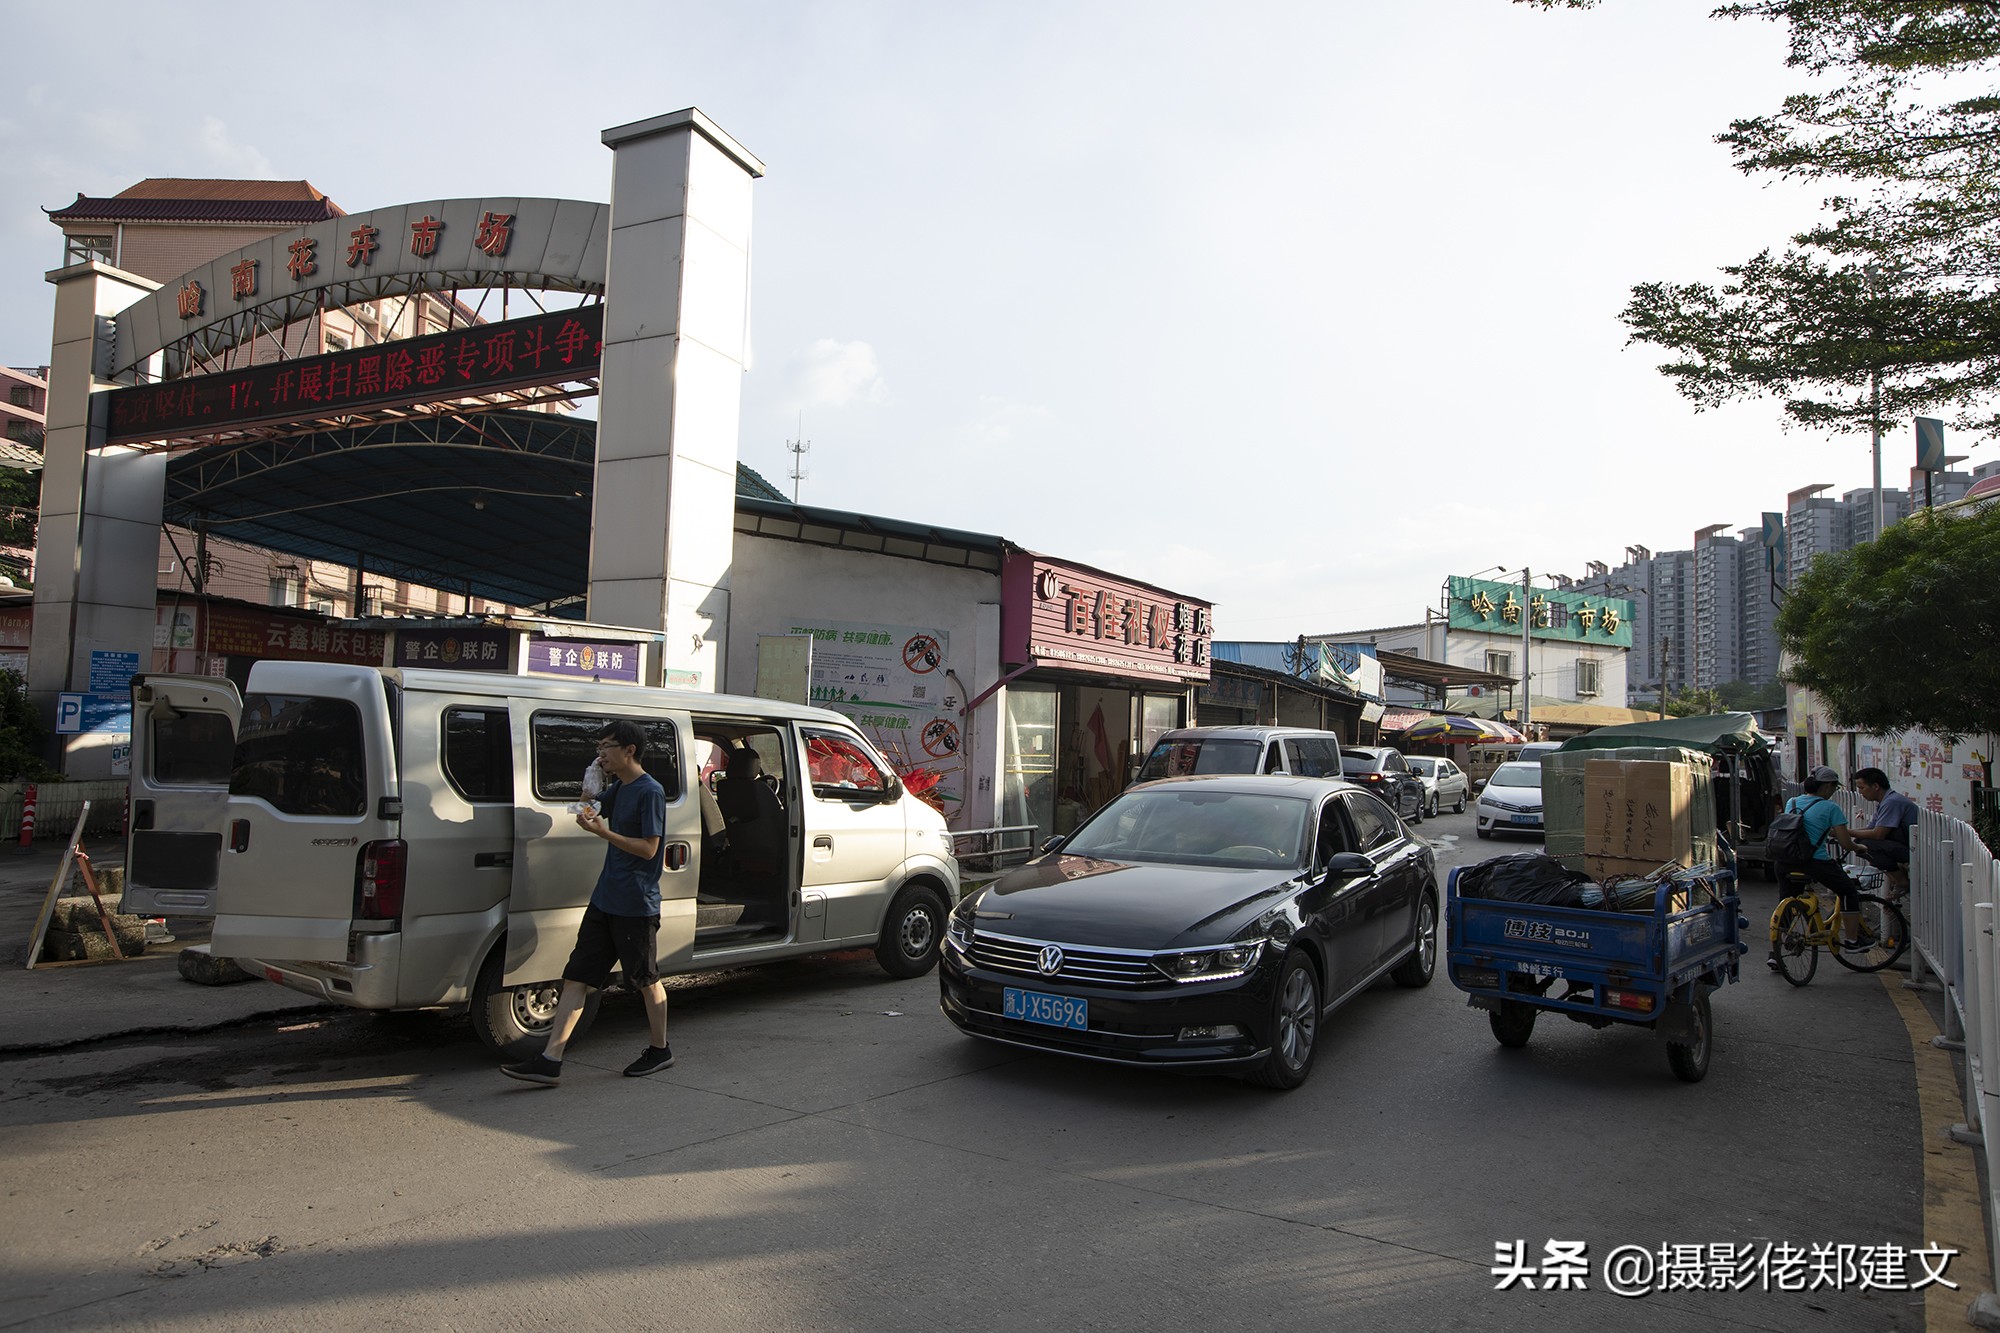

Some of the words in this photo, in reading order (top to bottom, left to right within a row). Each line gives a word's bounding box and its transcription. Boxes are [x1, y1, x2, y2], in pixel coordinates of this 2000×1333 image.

[177, 210, 515, 320] 岭南花卉市场
[1063, 585, 1171, 649] 百佳礼仪
[267, 622, 385, 658] 云鑫婚庆包装
[60, 702, 79, 725] P
[1504, 918, 1553, 940] 博技
[1555, 928, 1590, 940] BOJI
